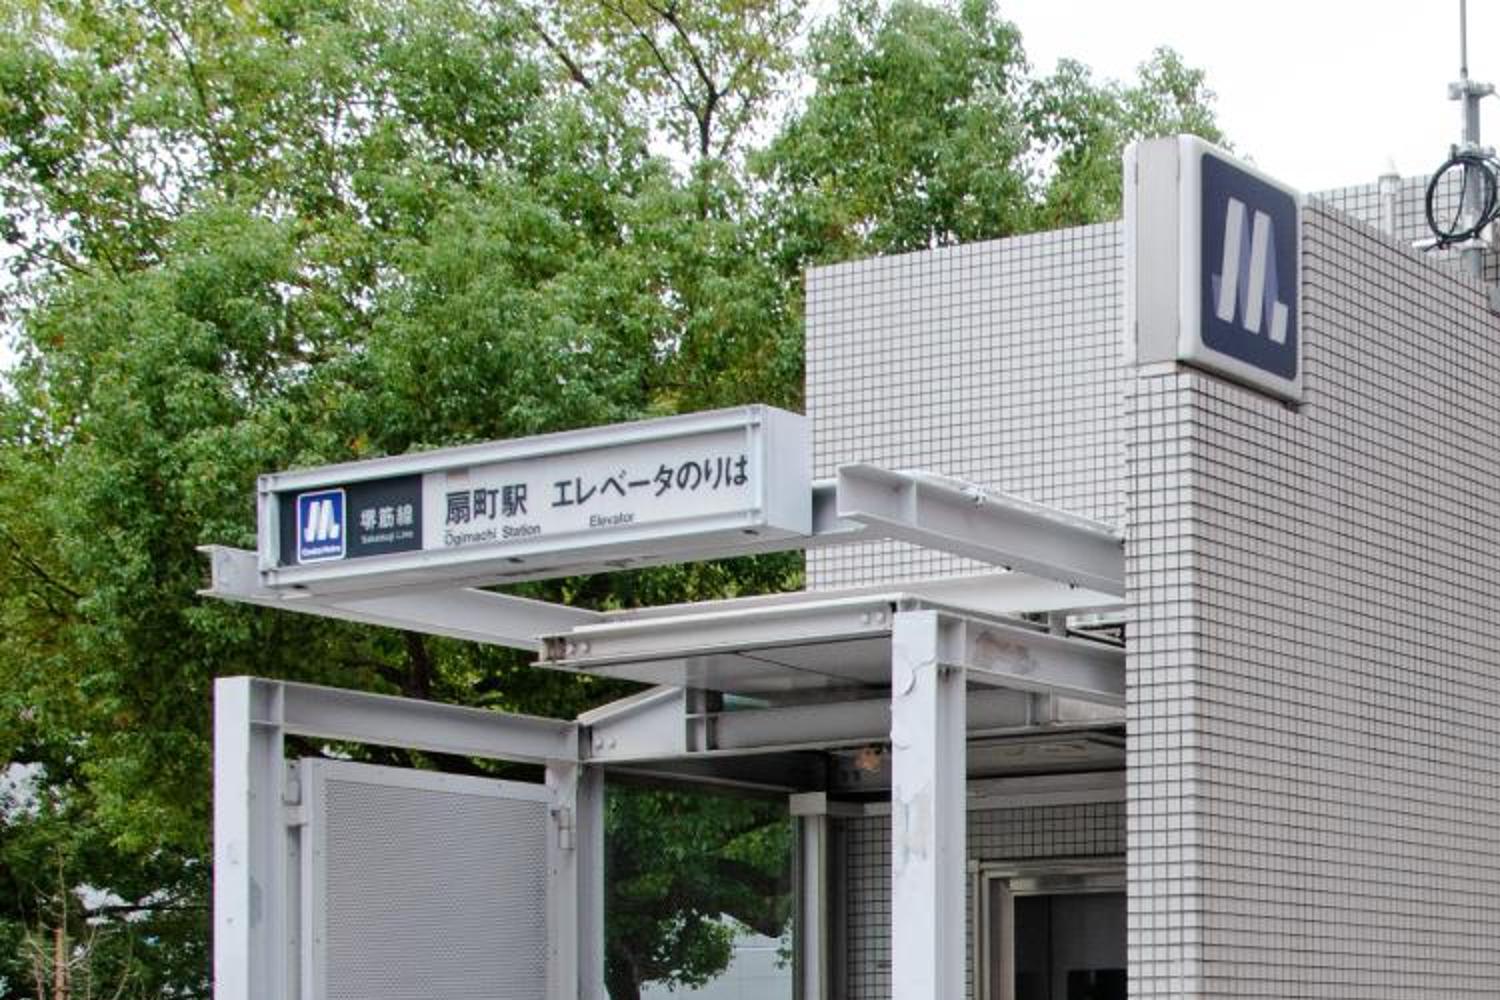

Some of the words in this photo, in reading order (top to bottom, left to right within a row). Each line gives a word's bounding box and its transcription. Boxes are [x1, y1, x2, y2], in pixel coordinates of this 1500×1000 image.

[446, 483, 527, 525] 扇町駅
[552, 455, 748, 507] エレベータのりは
[589, 511, 634, 527] Elevator
[502, 525, 541, 539] Station
